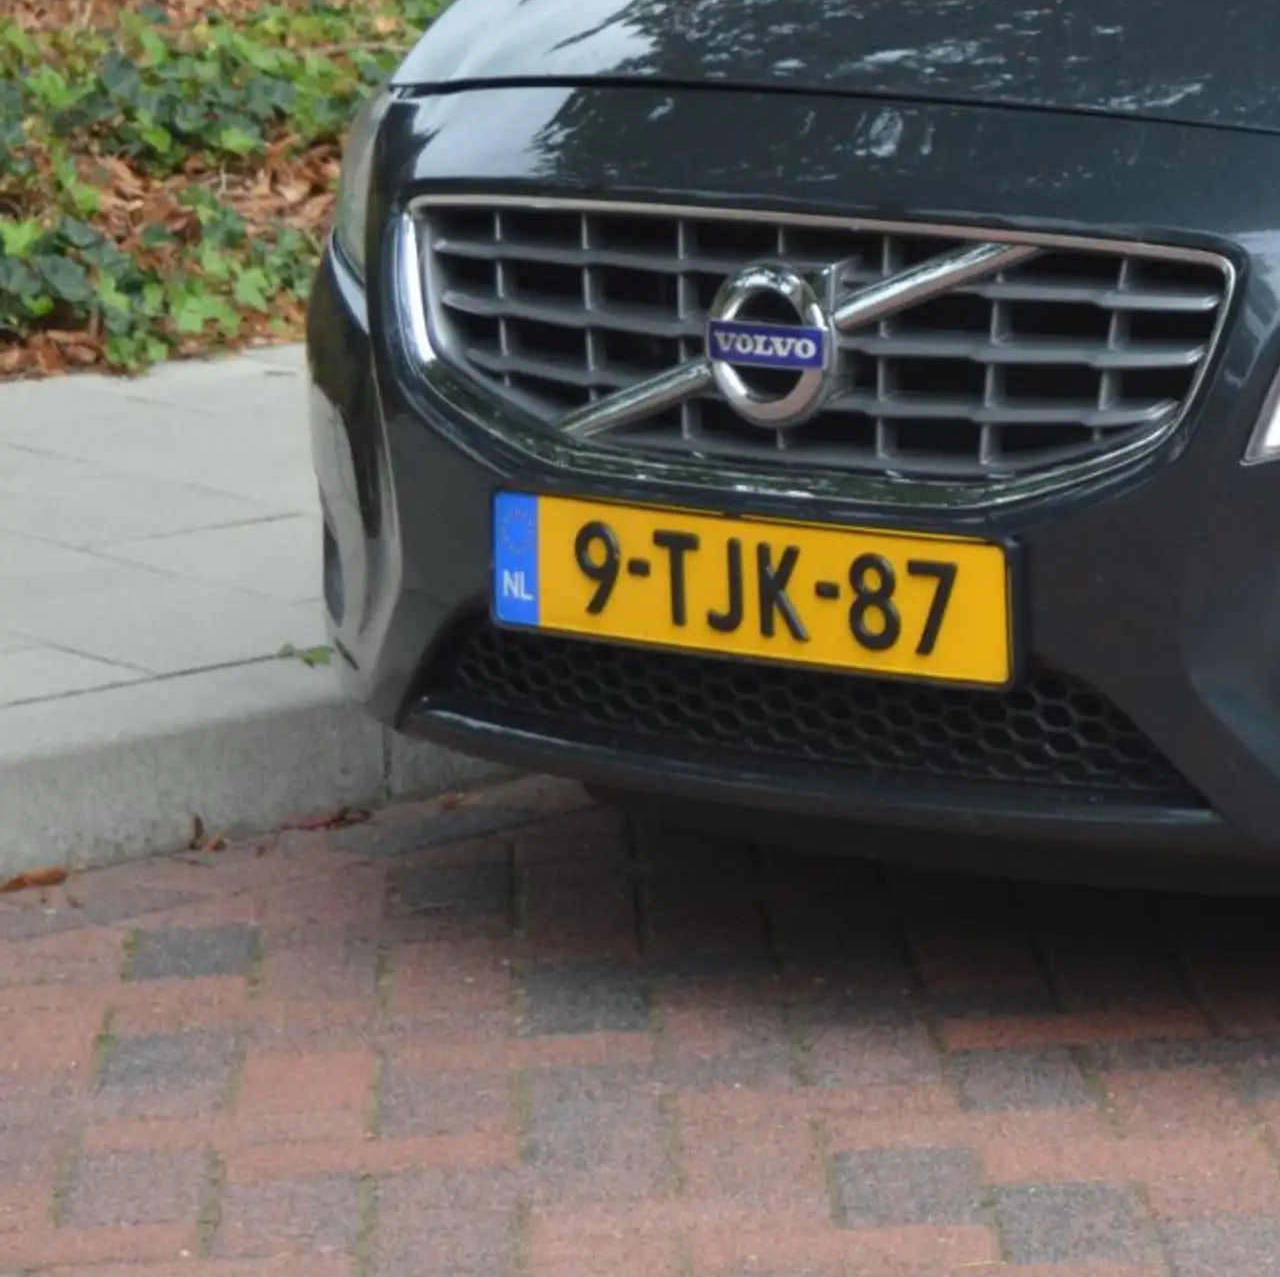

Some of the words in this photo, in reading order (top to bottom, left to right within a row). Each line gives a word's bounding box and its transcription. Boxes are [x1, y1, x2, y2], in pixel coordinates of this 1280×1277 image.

[713, 329, 817, 359] VOLVO
[502, 569, 534, 601] NL
[574, 520, 958, 656] 9-TJK-87
